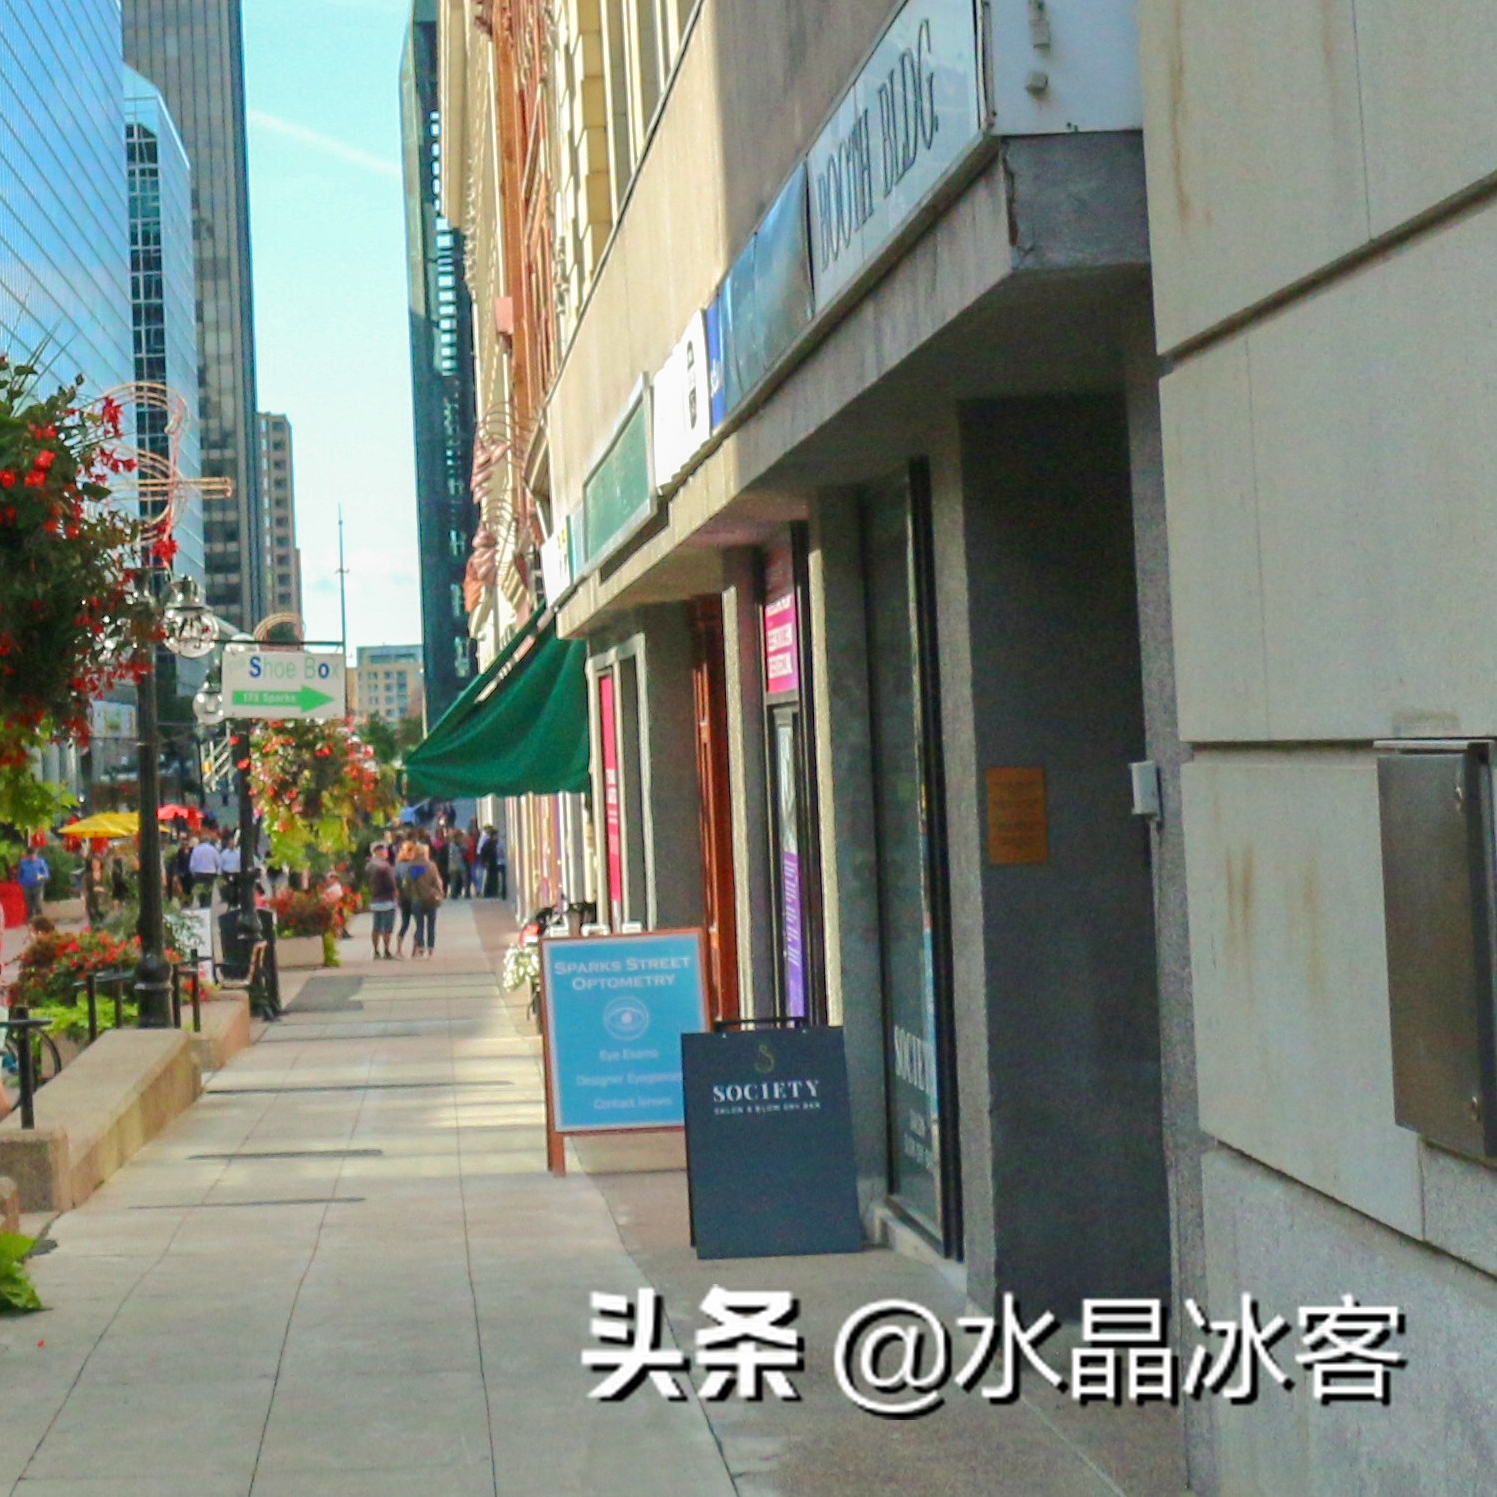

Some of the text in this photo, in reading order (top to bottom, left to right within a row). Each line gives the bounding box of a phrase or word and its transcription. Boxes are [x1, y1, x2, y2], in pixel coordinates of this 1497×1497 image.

[816, 18, 939, 273] BOOTH BLDG.
[249, 655, 296, 678] Shoe
[304, 657, 340, 680] Box
[571, 973, 676, 991] OPTOMETRY
[713, 1080, 819, 1102] SOCIETY
